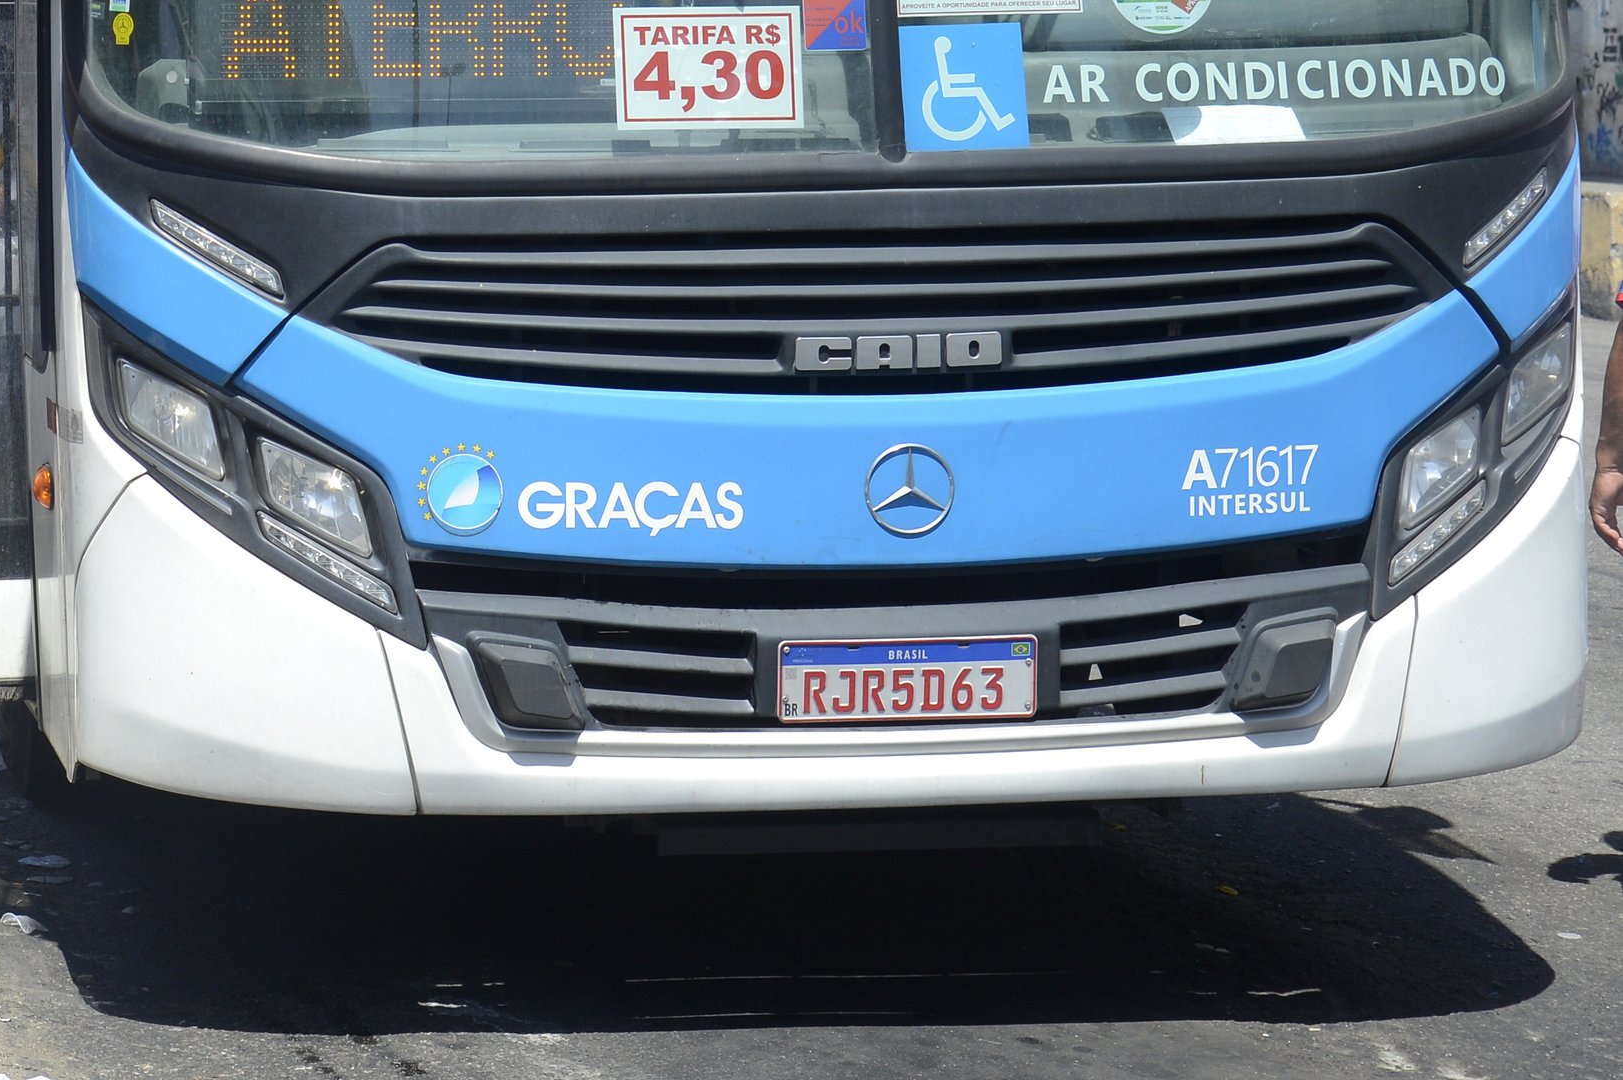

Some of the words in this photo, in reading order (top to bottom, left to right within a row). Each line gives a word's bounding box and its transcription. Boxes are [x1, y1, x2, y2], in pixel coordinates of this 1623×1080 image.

[633, 25, 736, 46] TARIFA
[745, 24, 782, 46] R$
[834, 9, 865, 35] ok
[633, 49, 785, 113] 4,30
[1042, 64, 1110, 103] AR
[1135, 56, 1506, 102] CONDICIONADO
[795, 331, 1002, 371] CAIO
[1181, 444, 1319, 490] A71617
[518, 481, 744, 536] GRAÇAS
[1189, 491, 1311, 517] INTERSUL
[887, 648, 928, 661] BRASIL
[784, 703, 798, 717] BR
[802, 667, 1005, 715] RJR5D63
